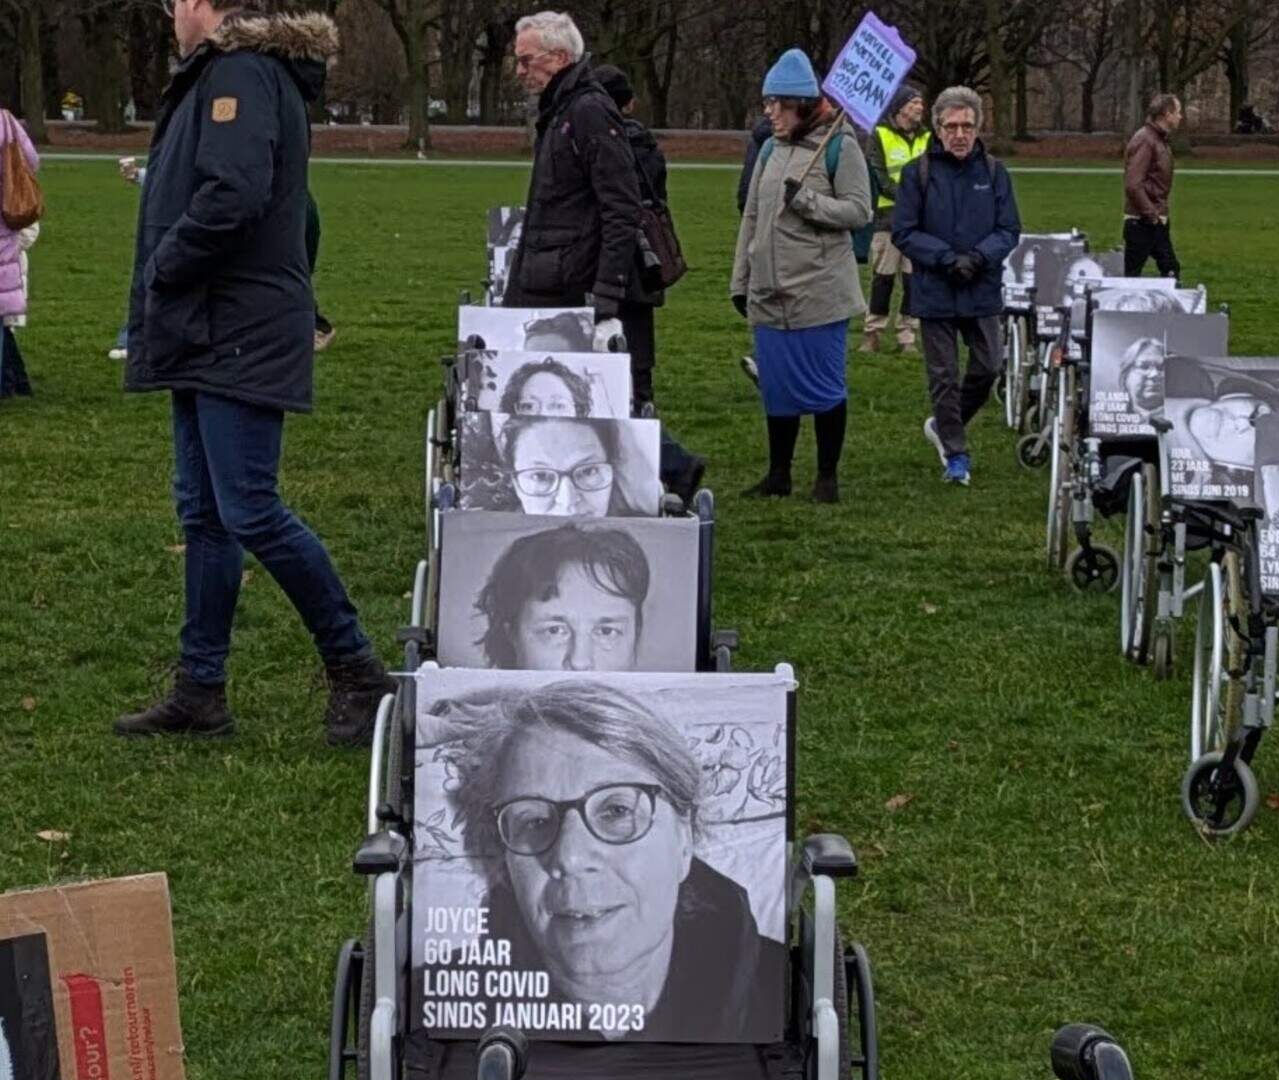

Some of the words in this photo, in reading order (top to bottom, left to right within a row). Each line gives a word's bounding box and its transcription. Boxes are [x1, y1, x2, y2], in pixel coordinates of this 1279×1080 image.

[851, 40, 882, 72] MOETEN
[881, 66, 896, 83] ER
[854, 70, 890, 110] GAAN
[1116, 413, 1140, 423] COVID
[1172, 472, 1185, 483] ME
[1187, 461, 1210, 472] JAAR
[1172, 484, 1199, 495] SINDS
[1223, 485, 1249, 496] 2019
[424, 907, 490, 934] JOYCE
[424, 939, 452, 965] 60
[458, 939, 511, 966] JAAR
[423, 970, 479, 997] LONG
[485, 971, 550, 998] COVID
[422, 1002, 487, 1028] SINDS
[492, 1003, 582, 1030] JANUARI
[588, 1004, 645, 1031] 2023
